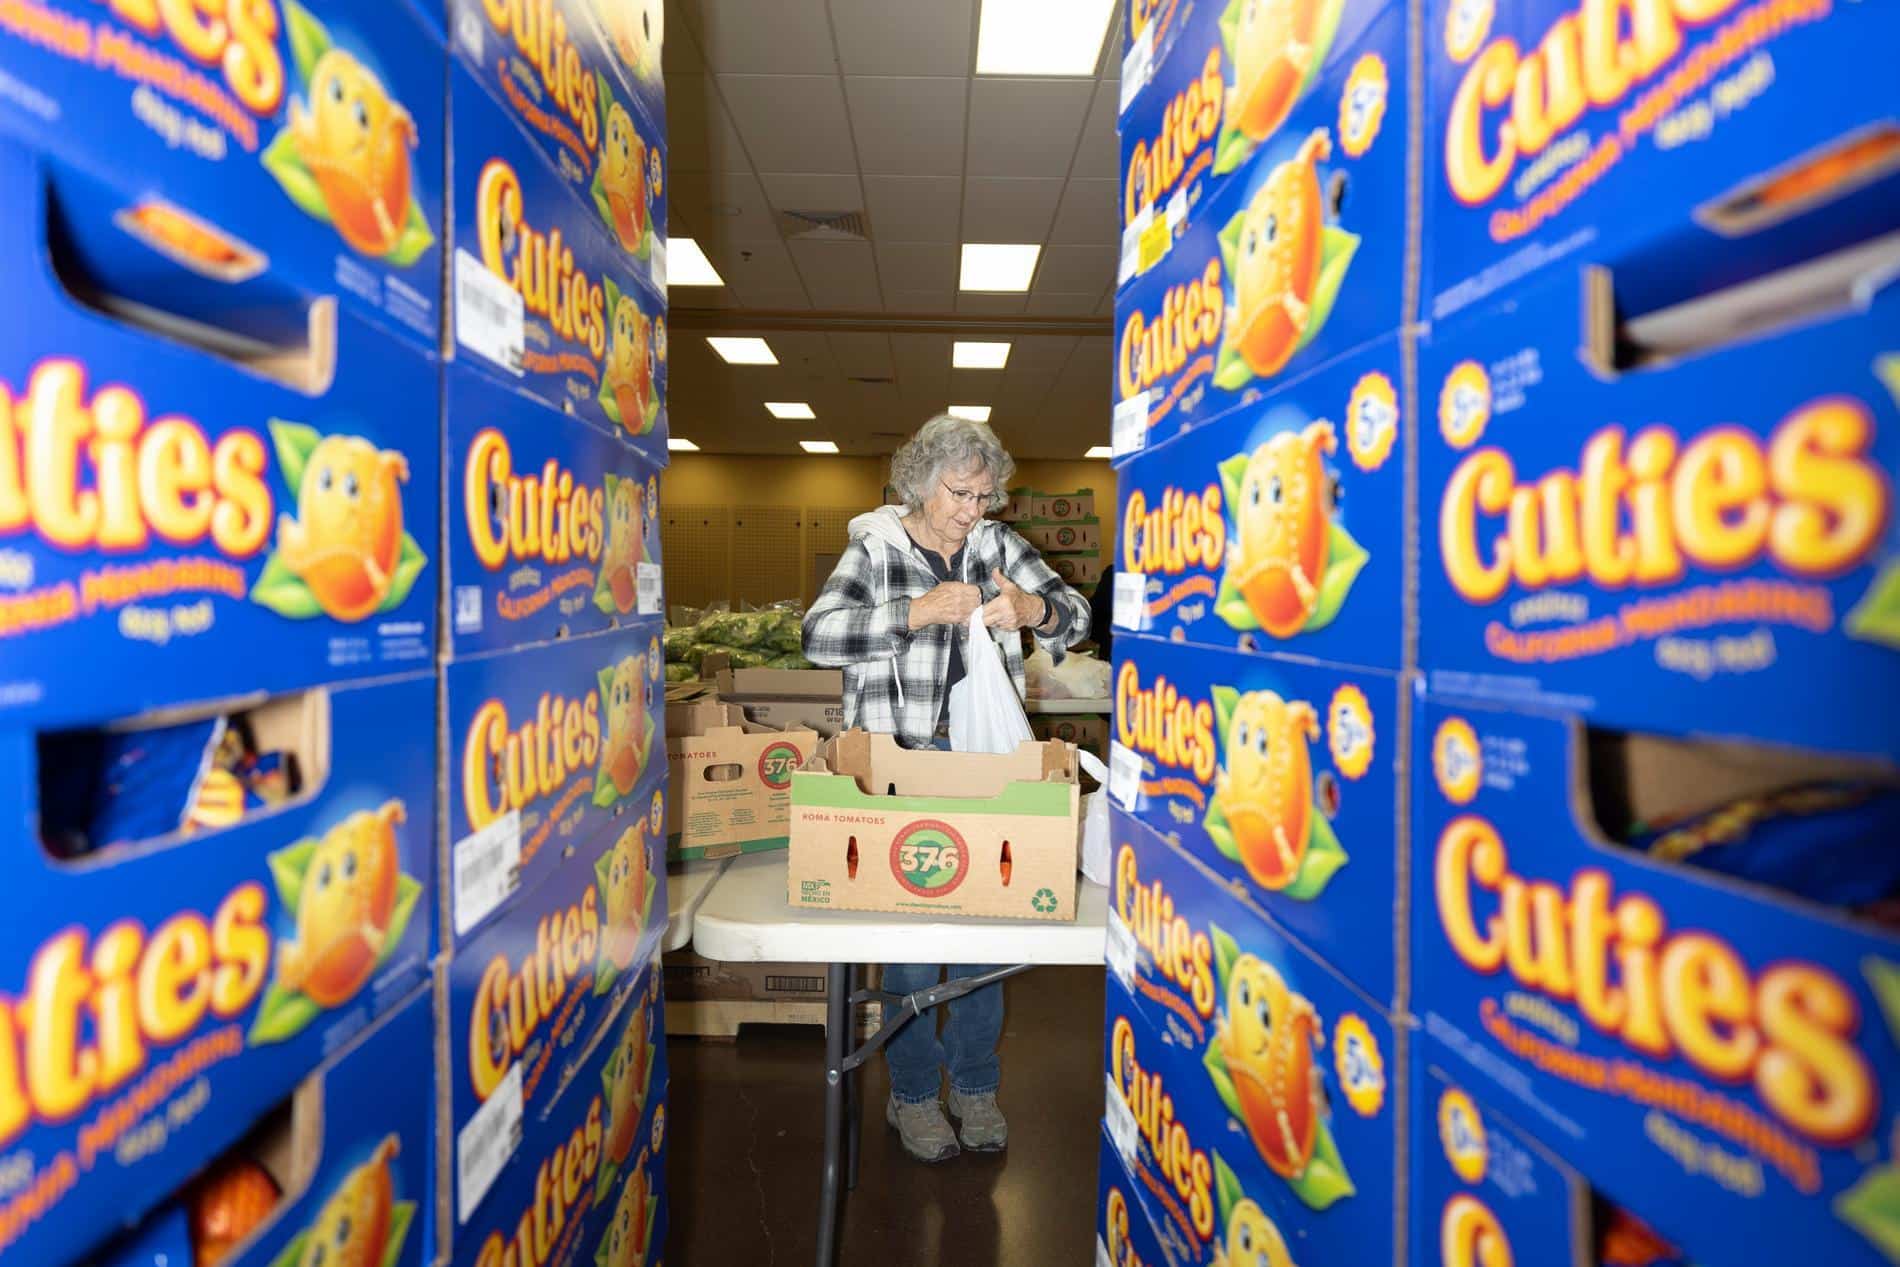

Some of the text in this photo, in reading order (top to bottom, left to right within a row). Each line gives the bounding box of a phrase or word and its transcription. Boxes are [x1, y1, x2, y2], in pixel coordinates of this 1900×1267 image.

[482, 0, 598, 150] uties
[1124, 43, 1224, 227] Cuties
[476, 157, 606, 360] Cuties
[1119, 257, 1224, 400] Cuties
[464, 426, 604, 573] Cuties
[1123, 483, 1226, 575] Cuties
[1439, 392, 1892, 604] Cuties
[463, 689, 599, 833] Cuties
[764, 757, 797, 776] 376
[1116, 660, 1216, 785] Cuties
[802, 813, 886, 825] ROMA TOMATOES
[899, 845, 960, 873] 376
[468, 883, 598, 1105] Cuties
[1116, 843, 1215, 1020] Cuties
[1435, 811, 1880, 1146] Cuties
[1112, 1016, 1214, 1241] Cuties
